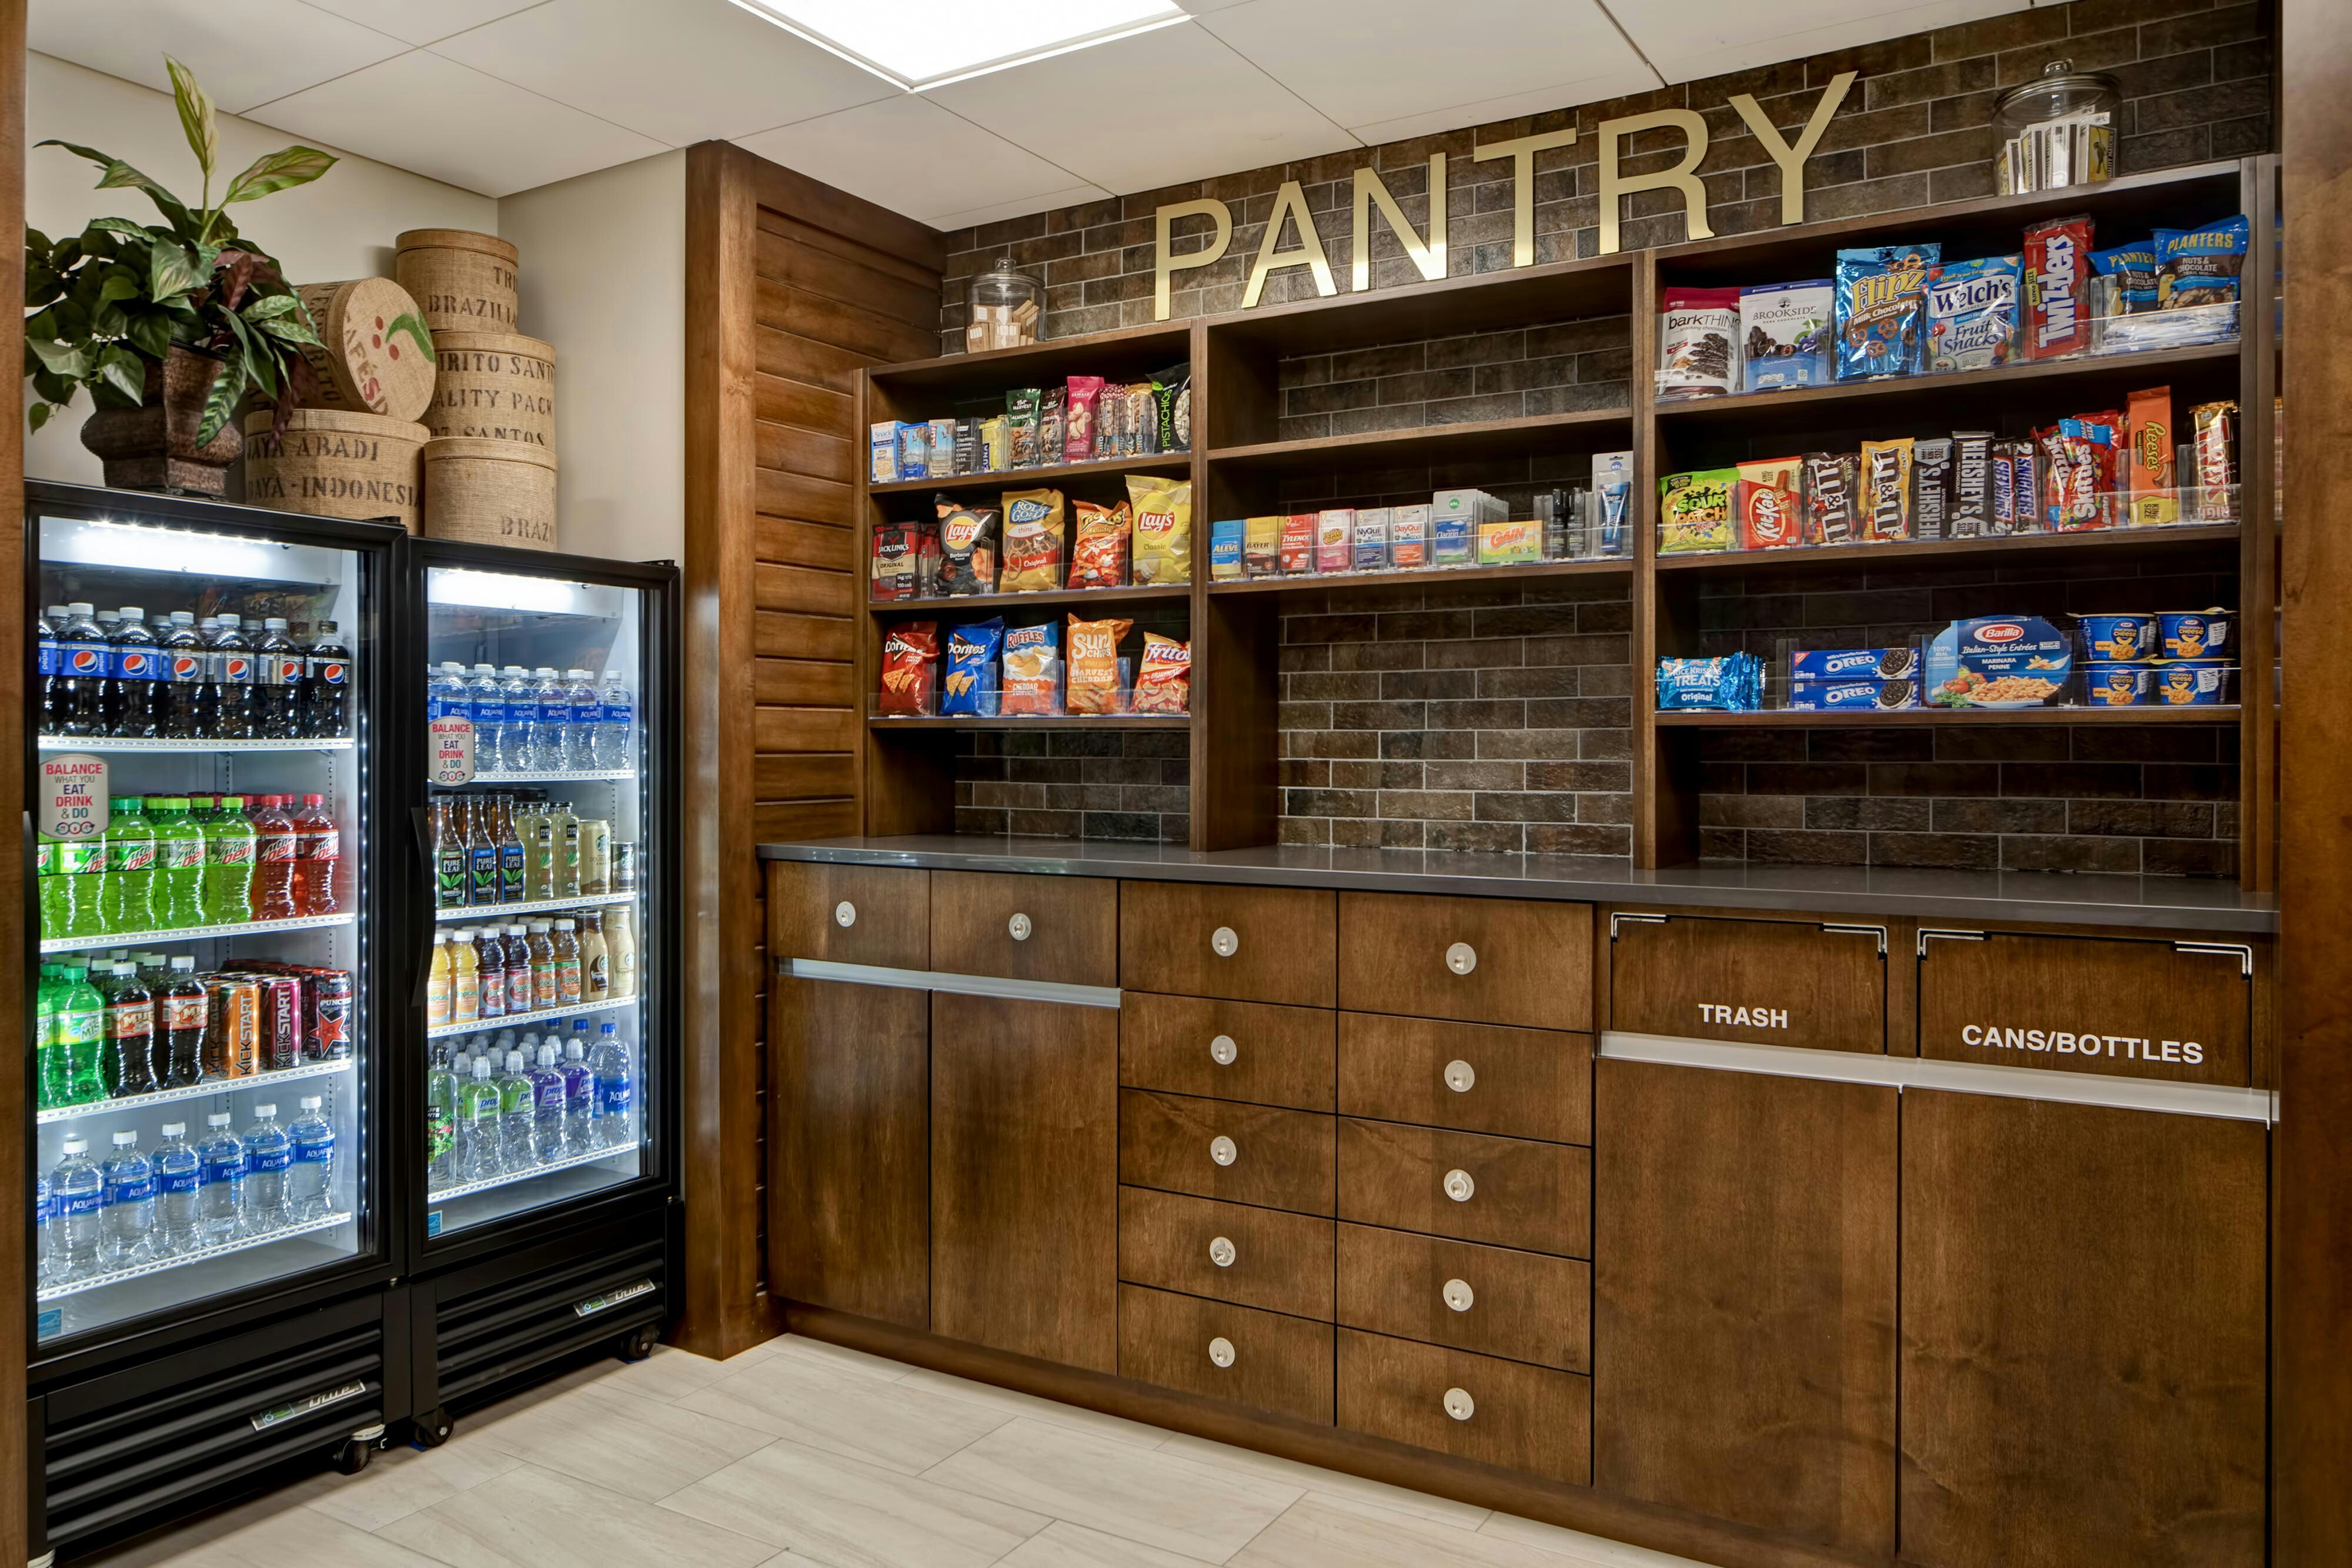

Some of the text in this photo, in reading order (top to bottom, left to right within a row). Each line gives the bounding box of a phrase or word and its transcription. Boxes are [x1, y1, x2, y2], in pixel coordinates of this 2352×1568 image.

[1154, 71, 1858, 321] PANTRY
[2167, 233, 2234, 255] PLANTERS
[2203, 256, 2210, 265] &
[2177, 264, 2217, 272] CHOCOLATE
[1851, 269, 1927, 317] Flipz
[1934, 279, 2012, 313] Welch's
[1753, 306, 1818, 320] BROOKSIDE
[1853, 312, 1872, 326] Milk
[1943, 319, 1999, 355] Fruit Snacks
[433, 389, 500, 409] ALITY
[1161, 389, 1172, 447] PISTACHIOS
[296, 436, 378, 461] ABADI
[2146, 420, 2167, 472] Reese's
[1959, 442, 1986, 515] HERSHEY'S
[2017, 457, 2035, 518] SNICKERS
[1677, 494, 1726, 513] SOUR
[1918, 467, 1941, 539] HERSHEY'S
[1140, 512, 1174, 532] Lay's
[1676, 506, 1727, 530] PATCH
[1088, 525, 1115, 534] Crunchy
[1357, 526, 1381, 537] NyQuil
[1394, 524, 1422, 533] DayQuil
[1282, 534, 1310, 543] TYLENOL
[878, 545, 891, 554] JACK
[1213, 544, 1239, 553] ALEVE
[1024, 557, 1047, 568] Original
[1007, 630, 1044, 648] RUFFLES
[1985, 628, 2020, 638] Barilla
[948, 642, 987, 655] Doritos
[1071, 633, 1111, 660] Sun
[1825, 655, 1876, 673] OREO
[1070, 668, 1114, 677] HARVEST
[1013, 683, 1038, 691] CHEDDAR
[1674, 674, 1721, 687] TREATS
[1681, 693, 1713, 703] Original
[1825, 686, 1876, 704] OREO
[432, 724, 470, 733] BALANCE
[439, 750, 464, 759] DRINK
[46, 763, 102, 775] BALANCE
[443, 760, 461, 768] & DO
[55, 775, 95, 784] WHAT YOU
[55, 795, 93, 807] DRINK
[61, 807, 89, 819] & DO
[1698, 1003, 1789, 1029] TRASH
[236, 995, 252, 1076] KICKSTART
[274, 988, 291, 1070] KICKSTART
[1962, 1024, 2204, 1065] CANS/BOTTLES
